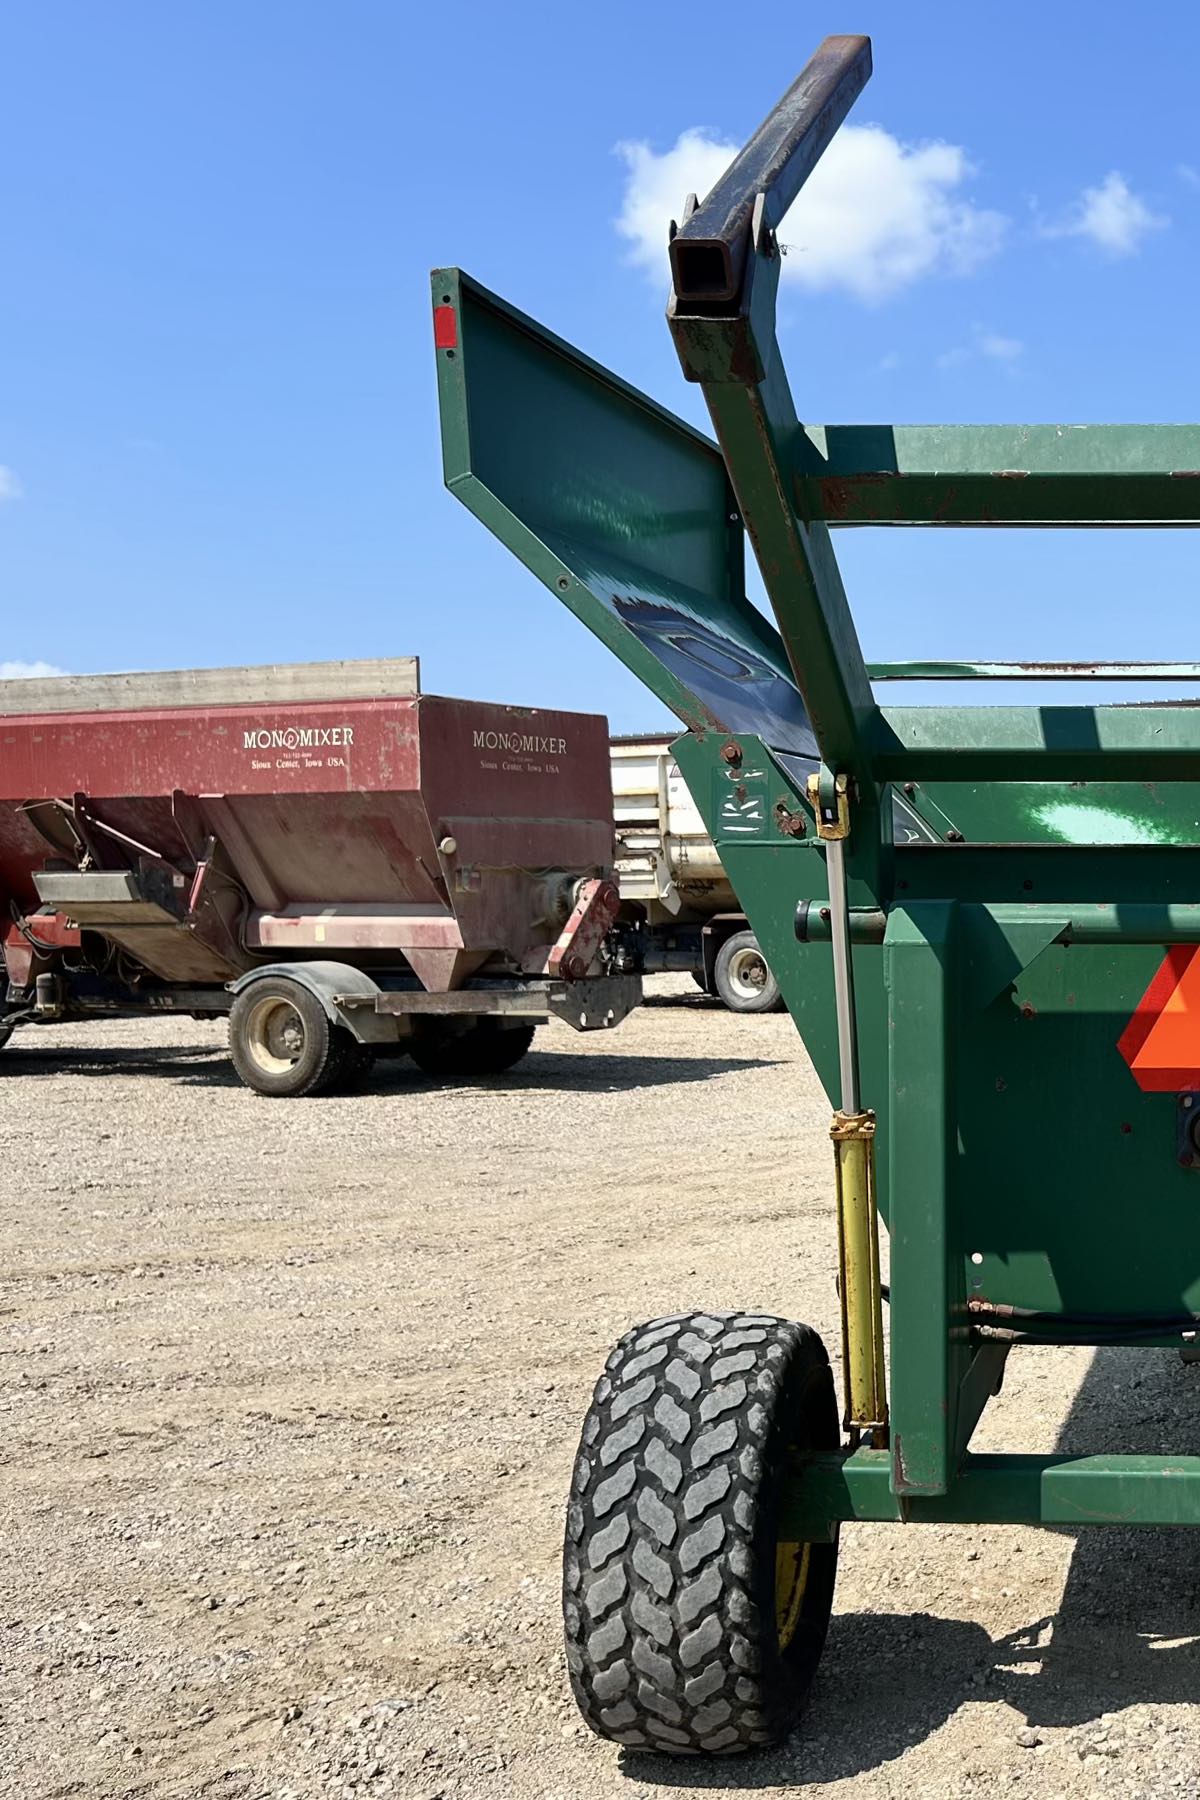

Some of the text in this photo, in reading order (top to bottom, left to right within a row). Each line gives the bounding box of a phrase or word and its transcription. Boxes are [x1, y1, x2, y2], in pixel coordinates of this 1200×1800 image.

[243, 728, 354, 749] MONOMIXER
[473, 730, 567, 754] MONOMIXER
[251, 757, 345, 770] Sioux Center, Iowa USA
[480, 760, 498, 770] Sioux
[527, 763, 542, 773] Iowa
[545, 764, 560, 774] USA
